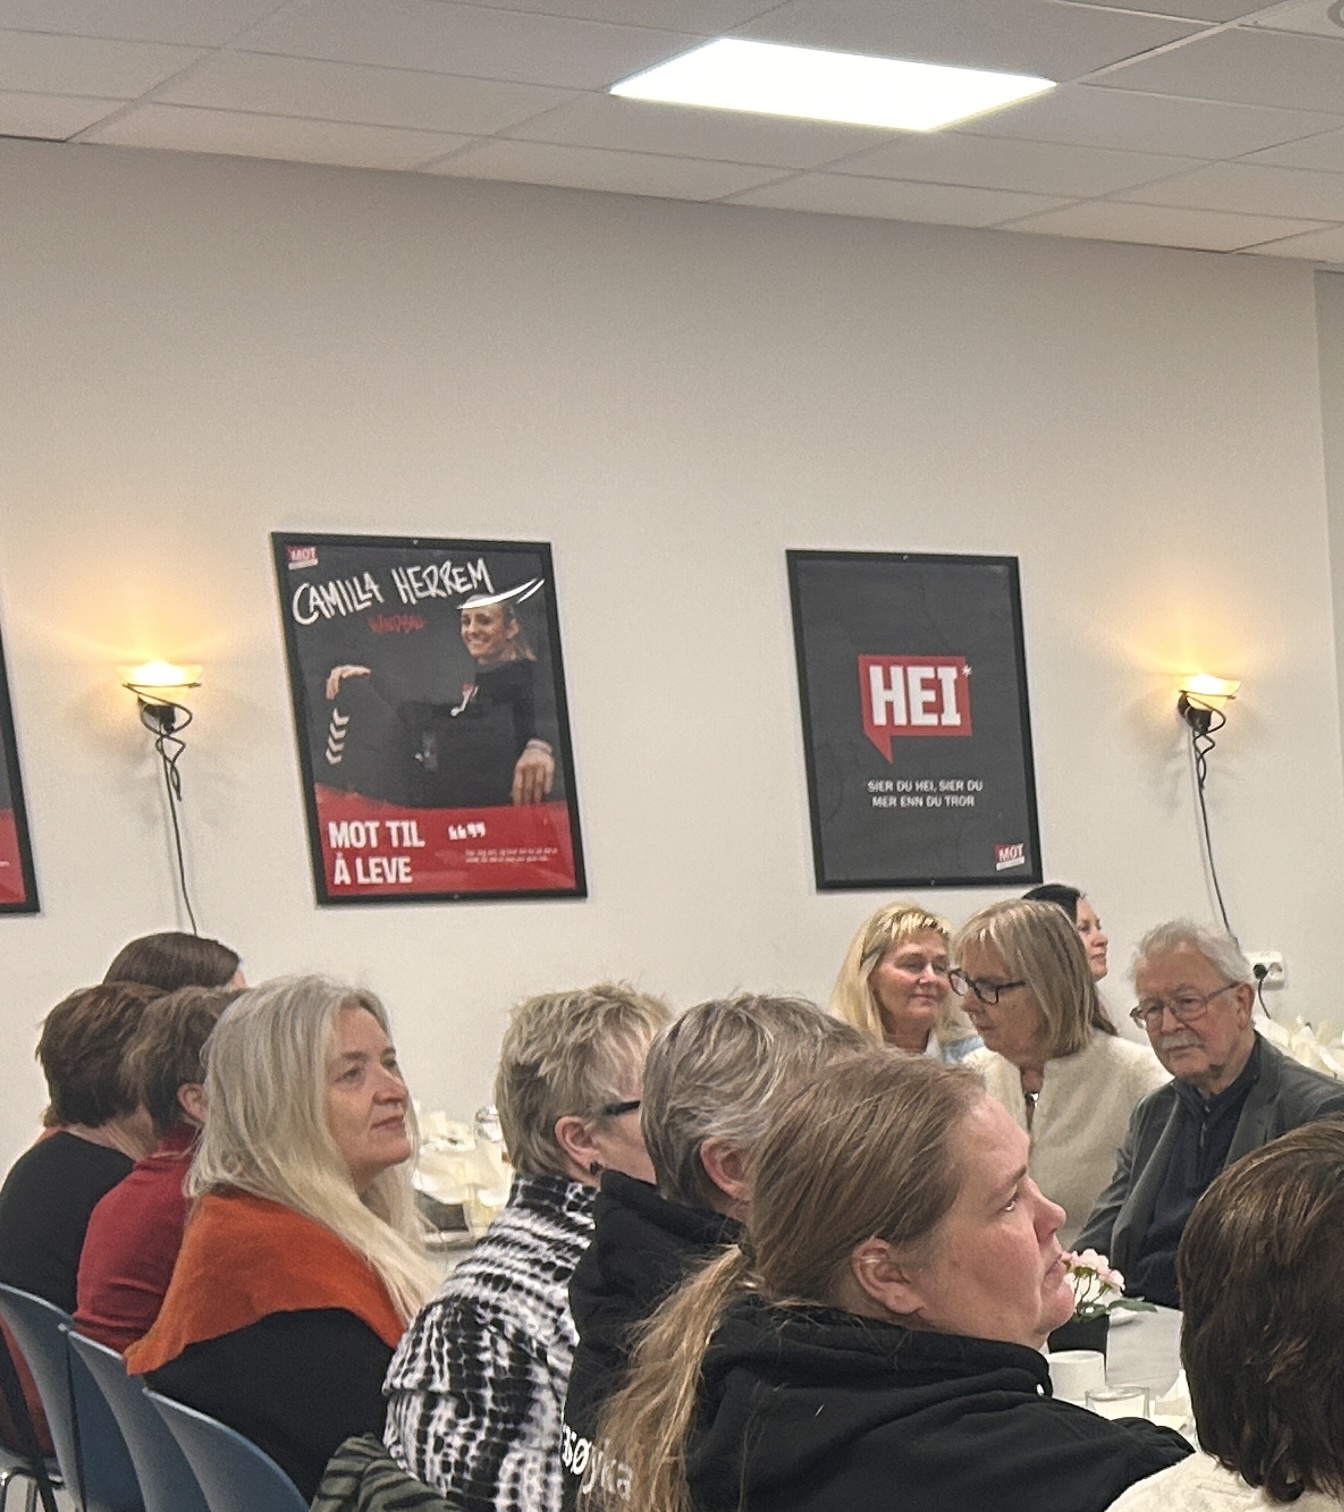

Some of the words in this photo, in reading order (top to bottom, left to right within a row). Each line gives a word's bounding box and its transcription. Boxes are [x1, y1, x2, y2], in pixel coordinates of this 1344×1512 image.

[292, 571, 385, 626] CAMILLA
[391, 557, 495, 605] HERREM
[869, 665, 962, 726] HEI
[872, 795, 897, 807] MER
[926, 795, 942, 807] DU
[896, 779, 913, 792] DU
[967, 779, 984, 792] DU
[328, 820, 380, 849] MOT
[385, 820, 426, 848] TIL
[334, 851, 352, 885] Å
[355, 856, 413, 885] LEVE
